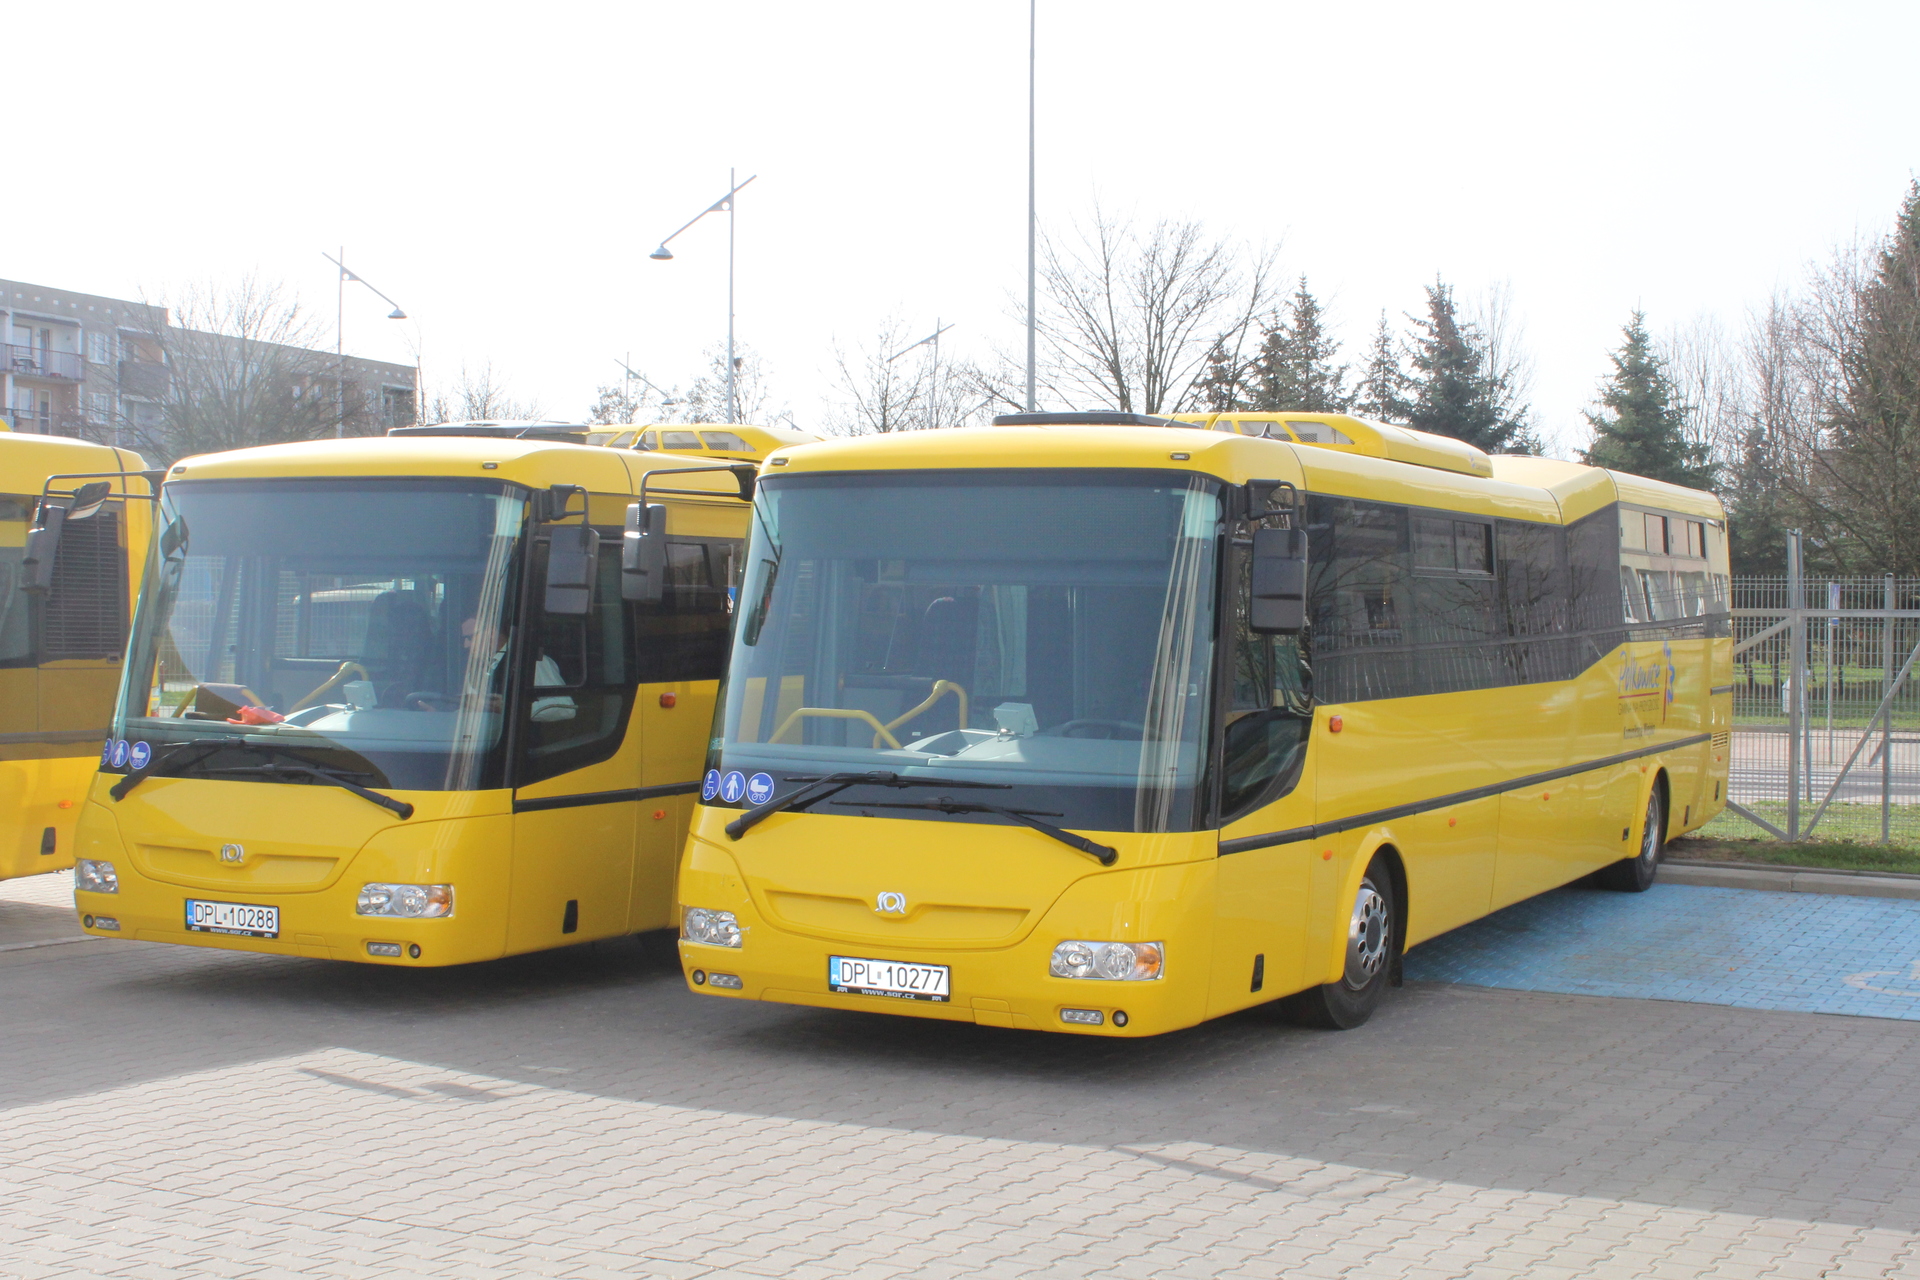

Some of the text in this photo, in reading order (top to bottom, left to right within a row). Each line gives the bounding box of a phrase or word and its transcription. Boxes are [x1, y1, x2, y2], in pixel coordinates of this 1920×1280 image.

[195, 904, 275, 929] DPL 10288
[210, 928, 253, 937] www.sor.cz
[841, 961, 944, 991] DPL 10277
[861, 988, 916, 1000] www.sor.cz
